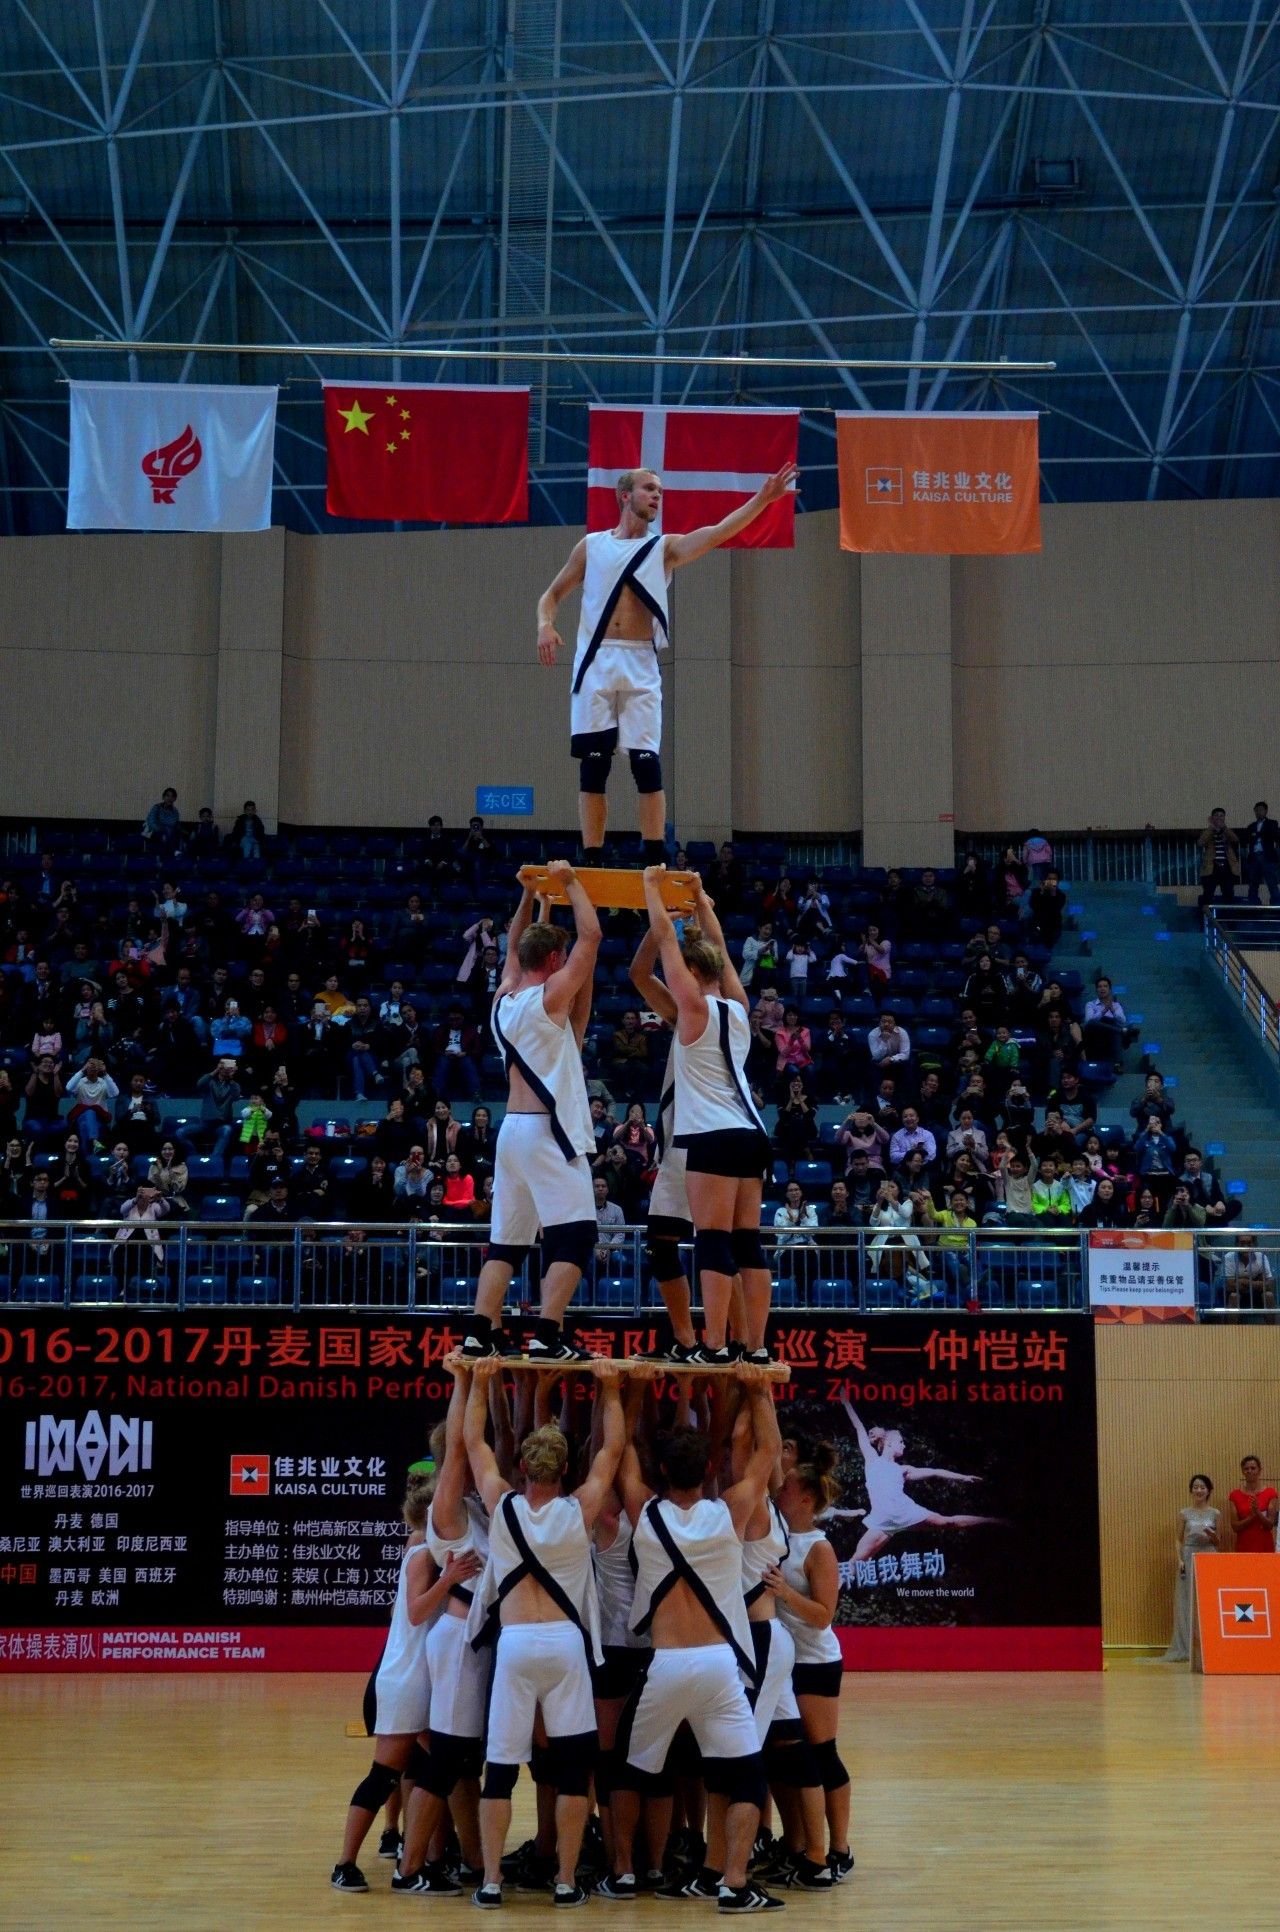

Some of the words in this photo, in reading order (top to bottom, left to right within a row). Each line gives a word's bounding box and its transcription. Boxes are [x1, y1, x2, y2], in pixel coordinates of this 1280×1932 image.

[912, 470, 1012, 490] 佳兆业文化
[912, 491, 950, 503] KAISA
[954, 491, 1013, 503] CULTURE
[484, 792, 527, 809] 东C区
[1122, 1261, 1160, 1272] 温馨提示
[1100, 1274, 1184, 1285] 贵重物品请妥善保管
[127, 1375, 248, 1397] National
[259, 1375, 357, 1398] Danish
[826, 1379, 957, 1407] Zhongkai
[962, 1381, 1063, 1402] station
[274, 1456, 387, 1477] 佳兆业文化
[20, 1484, 154, 1498] 世界巡回表演2016-2017
[274, 1483, 318, 1495] KAISA
[321, 1483, 387, 1496] CULTURE
[54, 1512, 83, 1529] 丹麦
[90, 1512, 119, 1529] 德国
[48, 1536, 106, 1552] 澳大利亚
[117, 1536, 188, 1552] 印度尼西亚
[1, 1563, 37, 1584] 中国
[49, 1567, 91, 1584] 墨西哥
[99, 1567, 127, 1583] 美国
[135, 1567, 177, 1584] 西班牙
[55, 1590, 84, 1606] 丹麦
[91, 1589, 119, 1606] 欧洲
[897, 1587, 909, 1597] We
[911, 1589, 933, 1597] move
[935, 1587, 949, 1597] the
[951, 1587, 975, 1597] world
[102, 1632, 179, 1644] NATIONAL
[182, 1632, 241, 1644] DANISH
[102, 1647, 219, 1659] PERFORMANCE
[222, 1647, 266, 1659] TEAM
